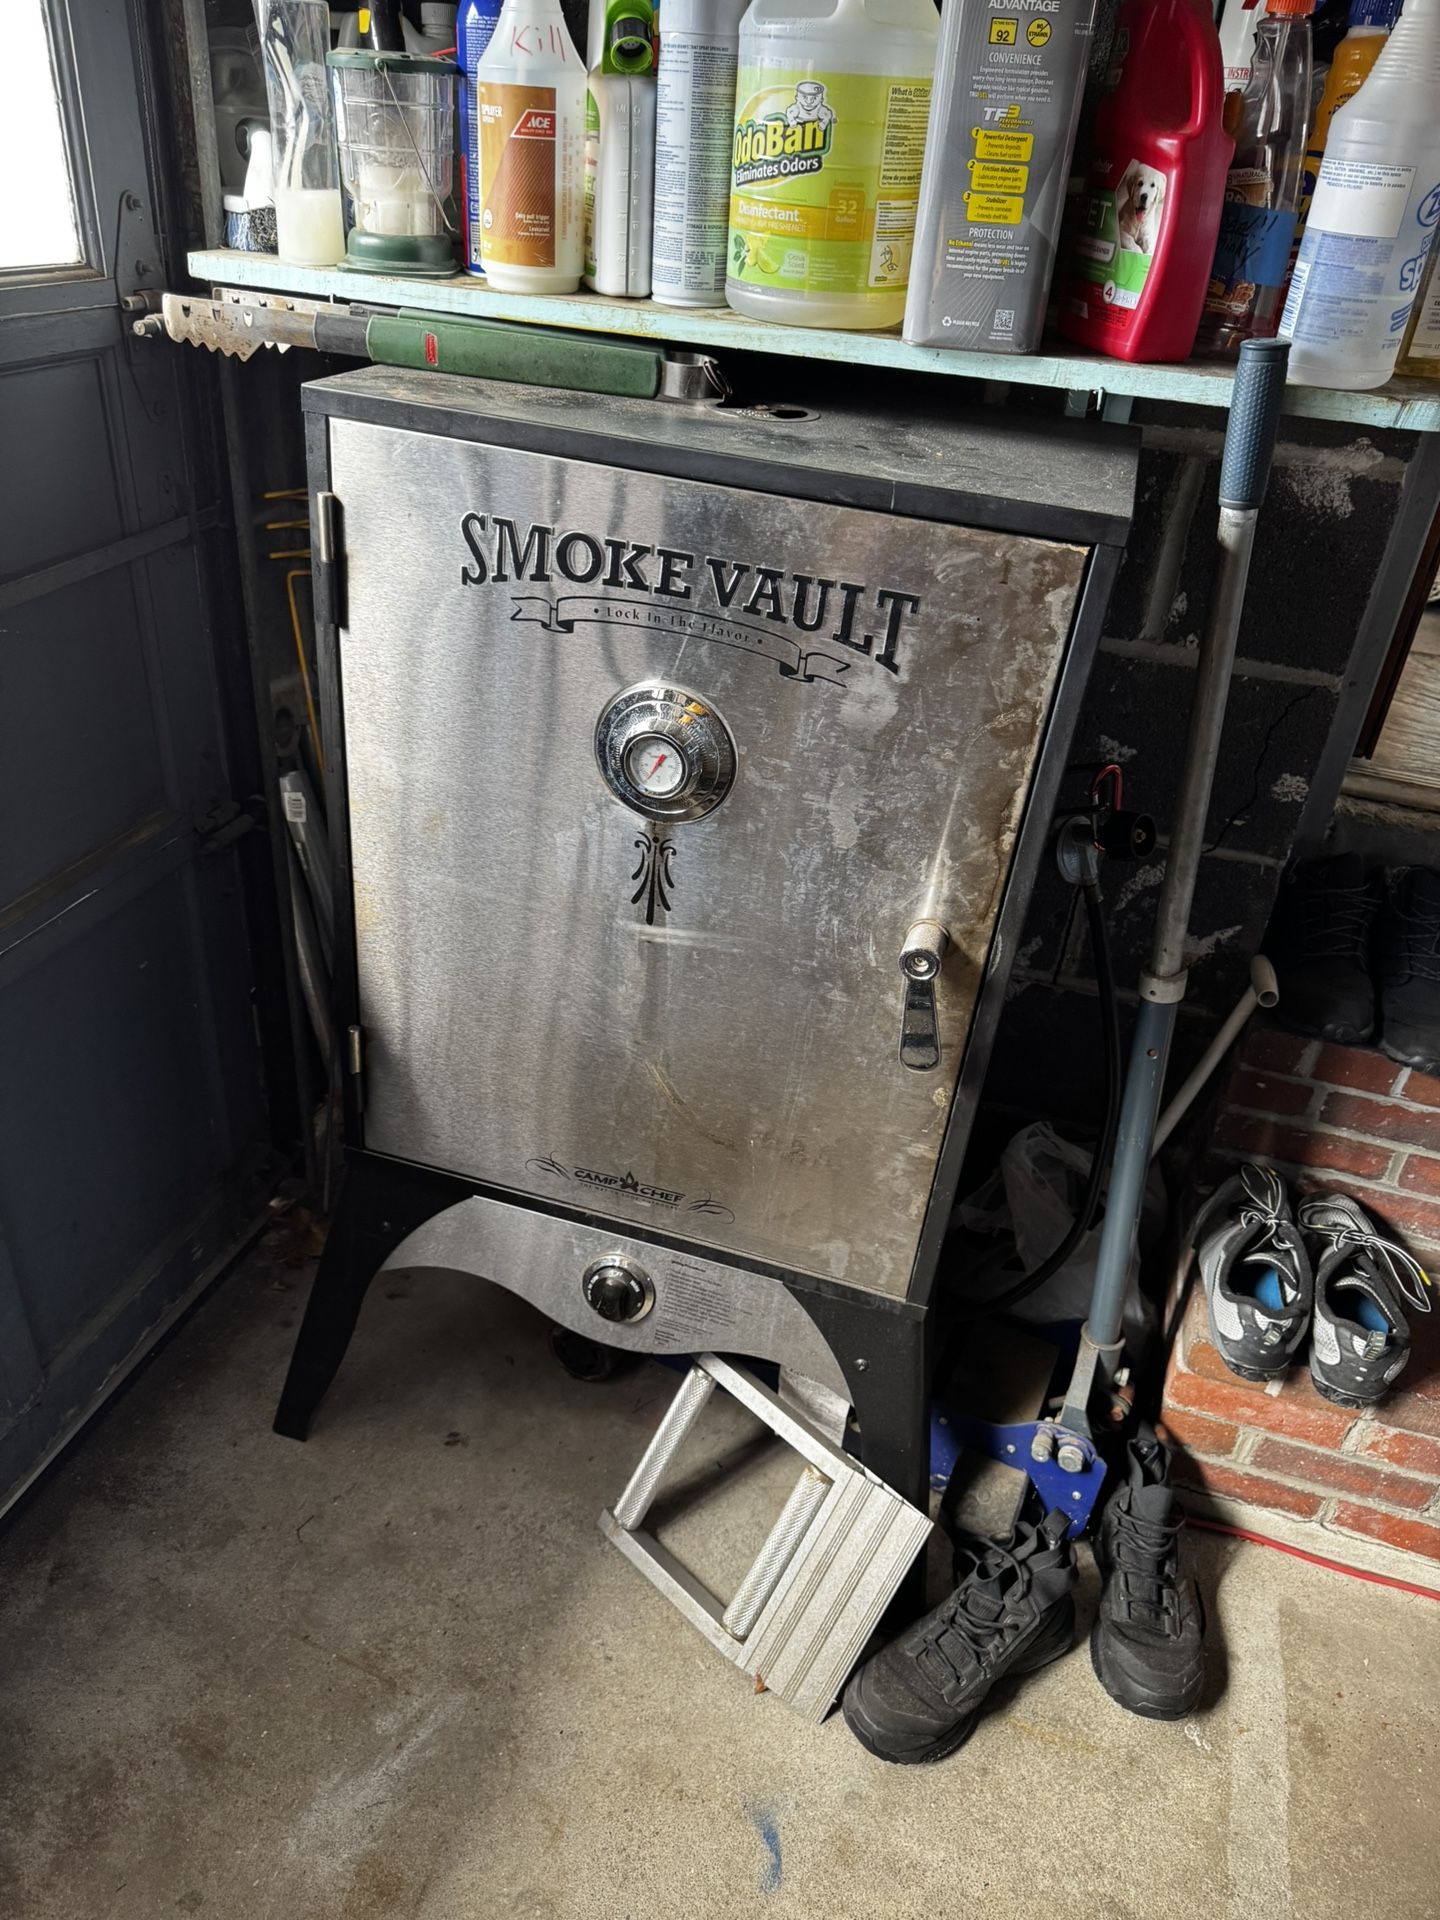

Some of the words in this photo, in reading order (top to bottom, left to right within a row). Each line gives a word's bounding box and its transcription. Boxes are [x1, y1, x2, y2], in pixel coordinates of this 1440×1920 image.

[988, 0, 1060, 12] ADVANTAGE
[996, 30, 1009, 42] 92
[510, 25, 565, 62] Kill
[989, 51, 1042, 65] CONVENIENCE
[891, 87, 907, 96] What
[527, 116, 551, 128] ACE
[734, 120, 824, 168] OdoBan
[1004, 134, 1028, 142] Detergent
[736, 164, 778, 183] Eliminates
[780, 158, 818, 174] Odors
[738, 201, 799, 222] Disinfectant
[837, 200, 857, 214] 32
[969, 228, 1014, 240] PROTECTION
[1106, 286, 1112, 299] 4
[461, 511, 694, 599] SMOKE
[706, 556, 920, 676] VAULT
[606, 607, 640, 620] Lock
[648, 612, 660, 624] In
[670, 615, 695, 629] The
[702, 622, 750, 642] Flavor
[574, 1170, 618, 1185] CAMP
[640, 1188, 683, 1202] CHEF
